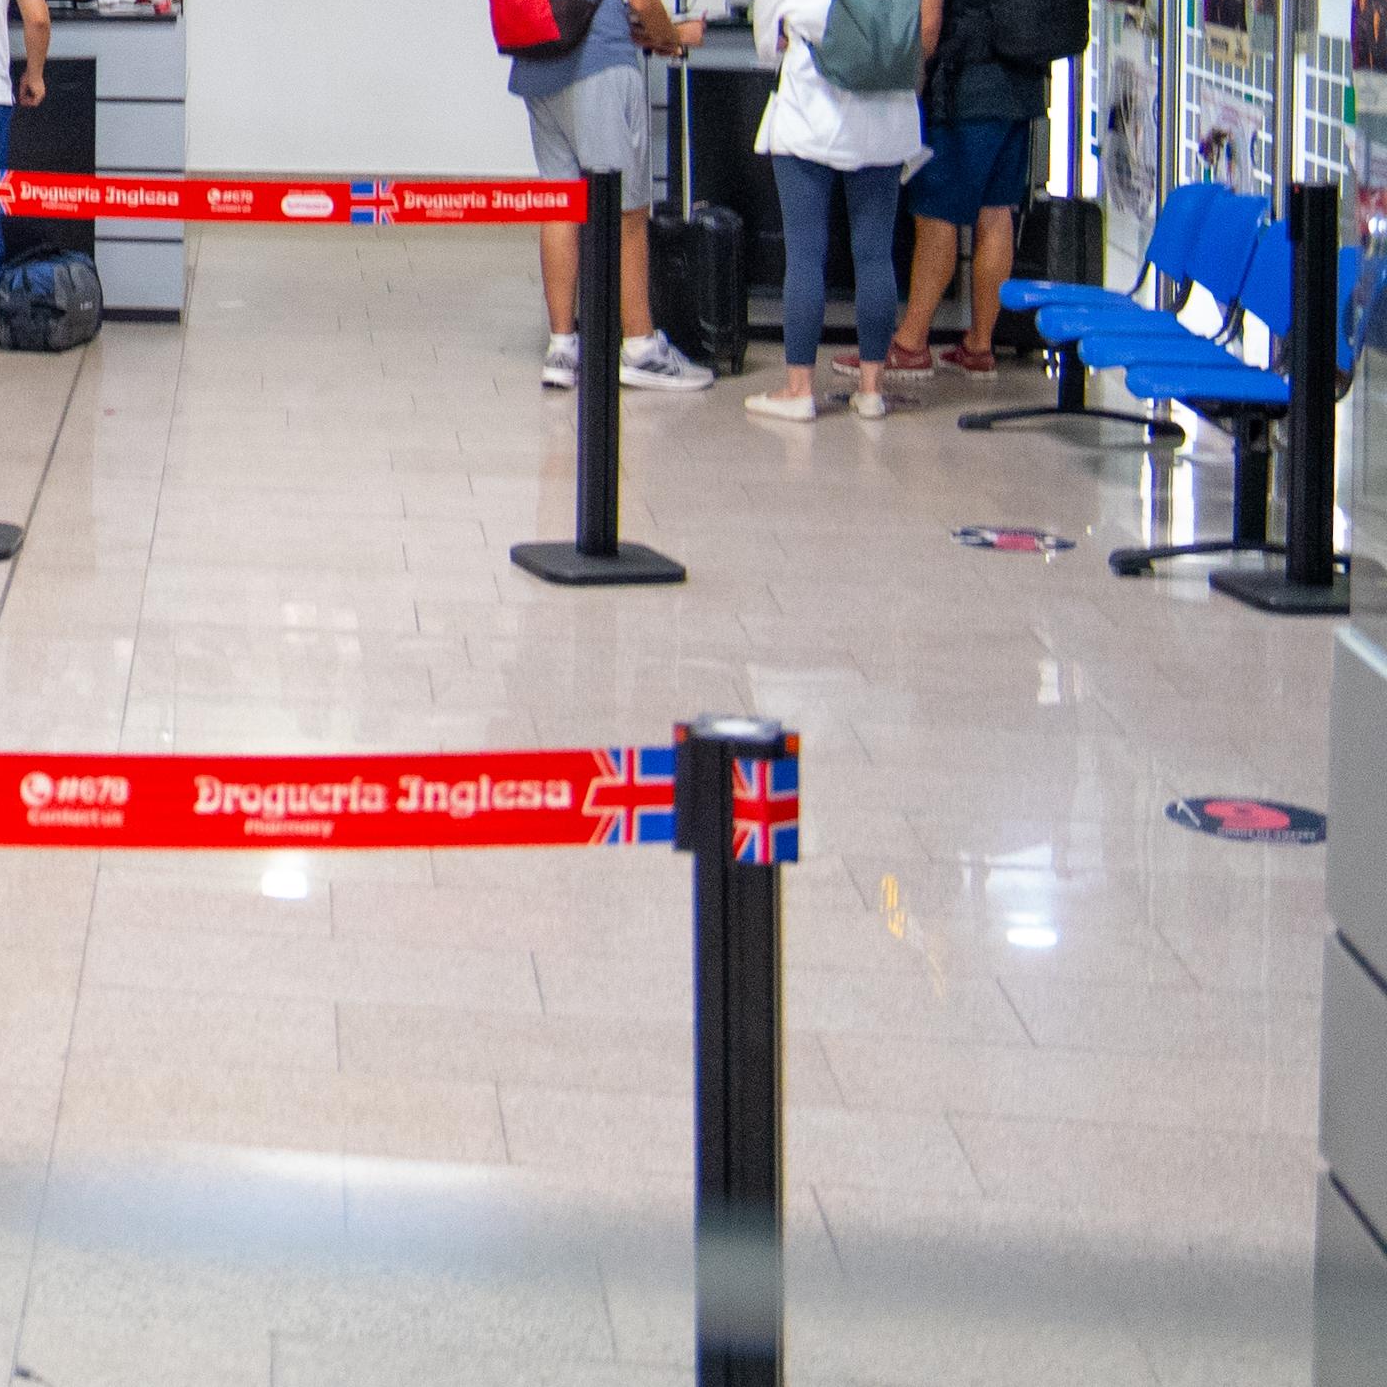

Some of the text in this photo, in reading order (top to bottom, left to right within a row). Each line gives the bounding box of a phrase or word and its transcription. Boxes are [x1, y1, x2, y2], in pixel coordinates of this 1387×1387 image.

[105, 185, 180, 207] Inglesa
[491, 189, 570, 211] Inglesa
[56, 775, 129, 805] #678
[193, 773, 572, 819] Droguería Inglesa
